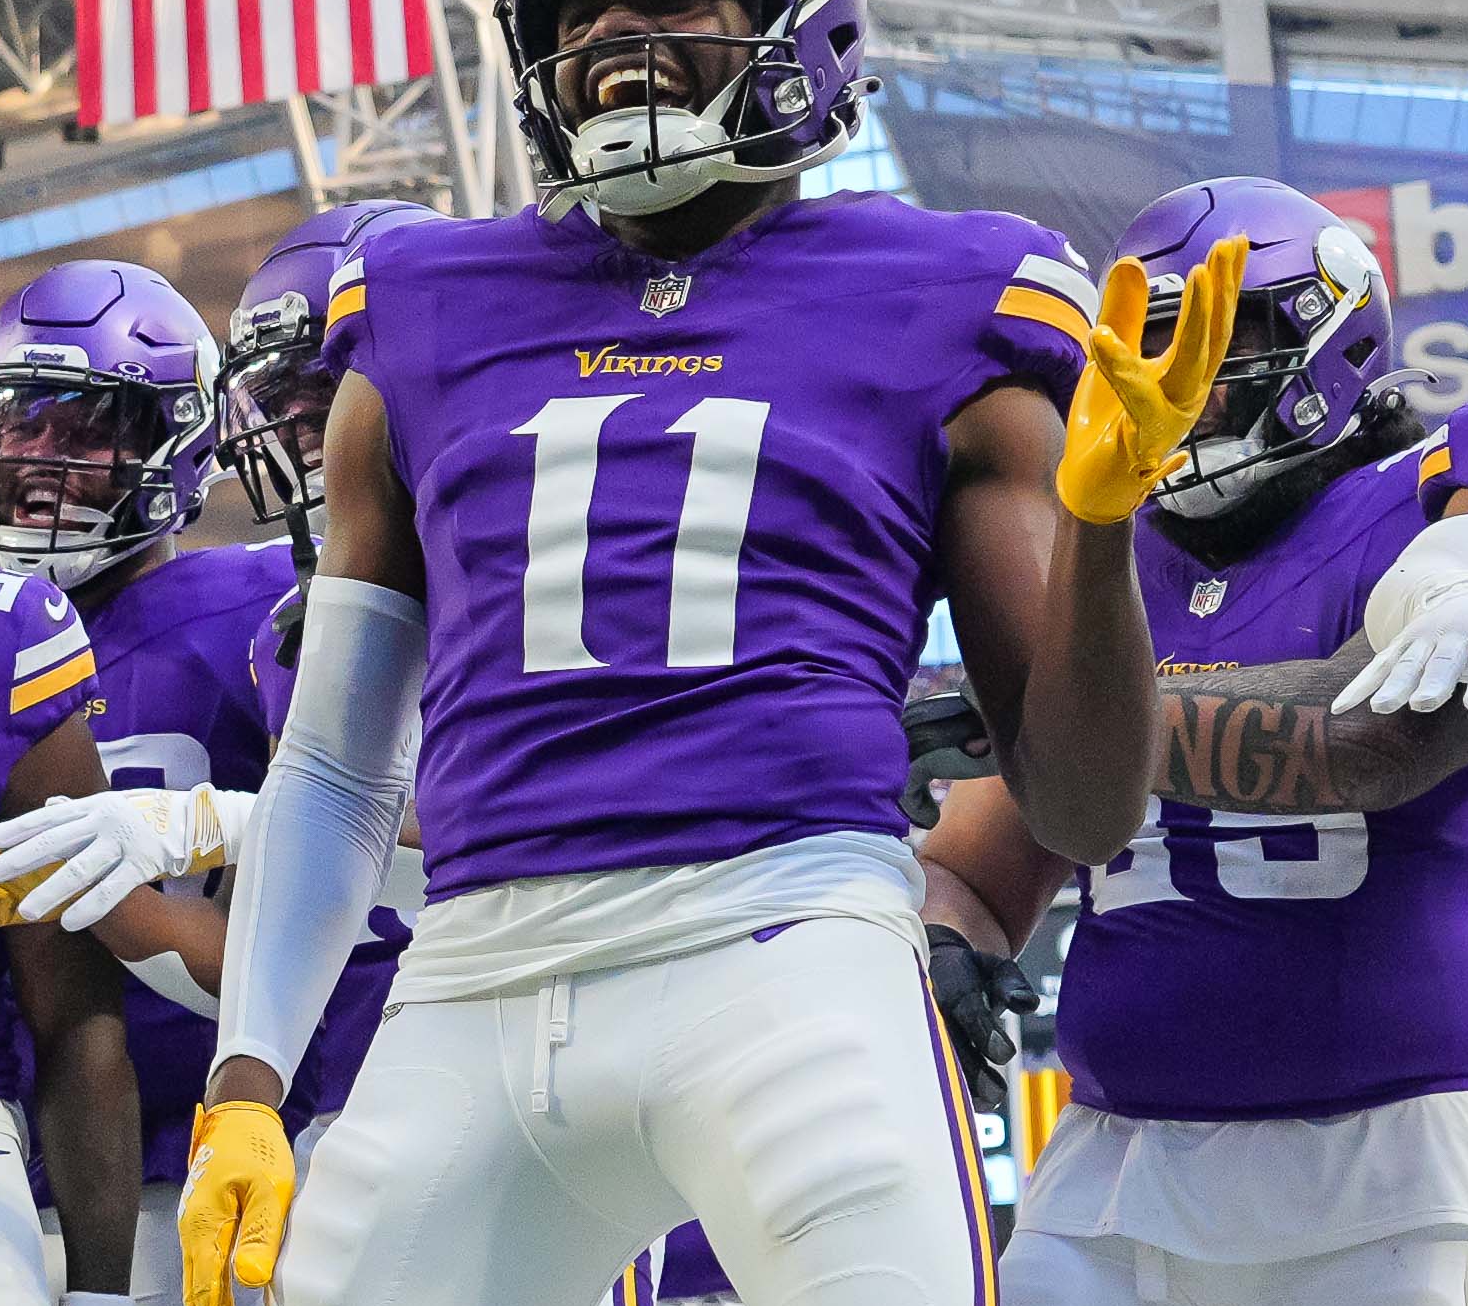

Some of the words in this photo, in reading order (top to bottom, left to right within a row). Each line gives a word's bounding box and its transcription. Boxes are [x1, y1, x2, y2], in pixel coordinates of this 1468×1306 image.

[649, 290, 677, 309] NFL
[509, 393, 772, 674] 11
[1194, 594, 1220, 610] NFL
